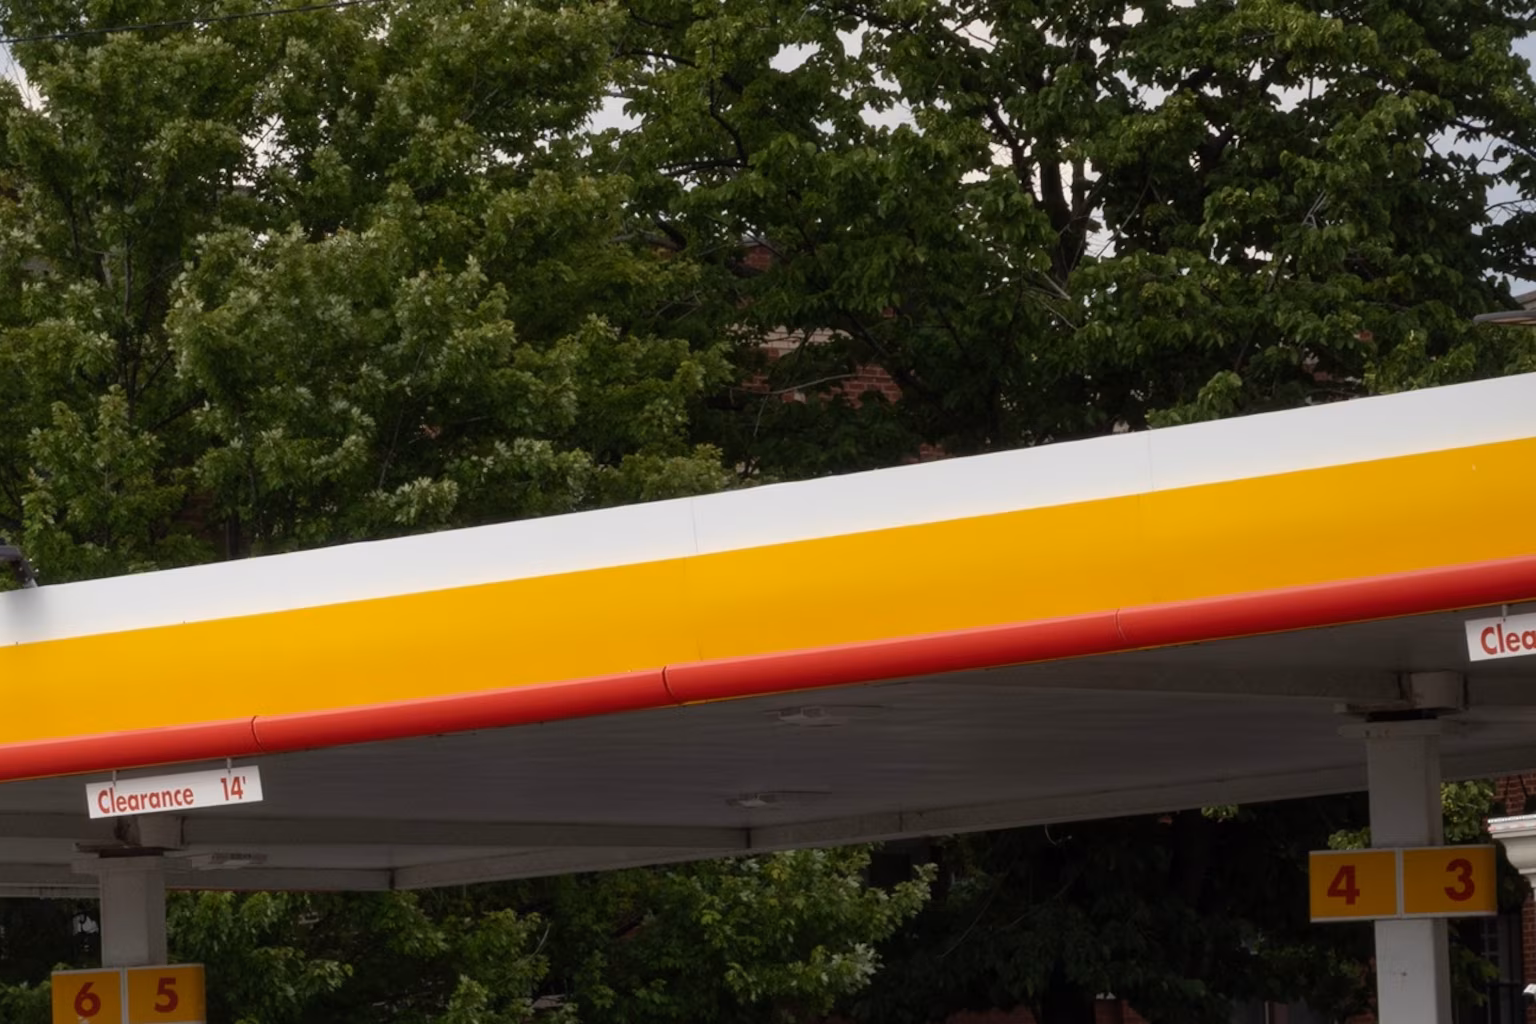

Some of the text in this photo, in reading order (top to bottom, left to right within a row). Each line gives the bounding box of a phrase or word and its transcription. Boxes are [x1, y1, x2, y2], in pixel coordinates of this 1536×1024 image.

[1481, 623, 1536, 655] Clea
[97, 775, 246, 814] Clearance 14'
[1327, 864, 1360, 905] 4
[1444, 858, 1475, 902] 3
[73, 981, 102, 1018] 6
[154, 977, 179, 1013] 5
